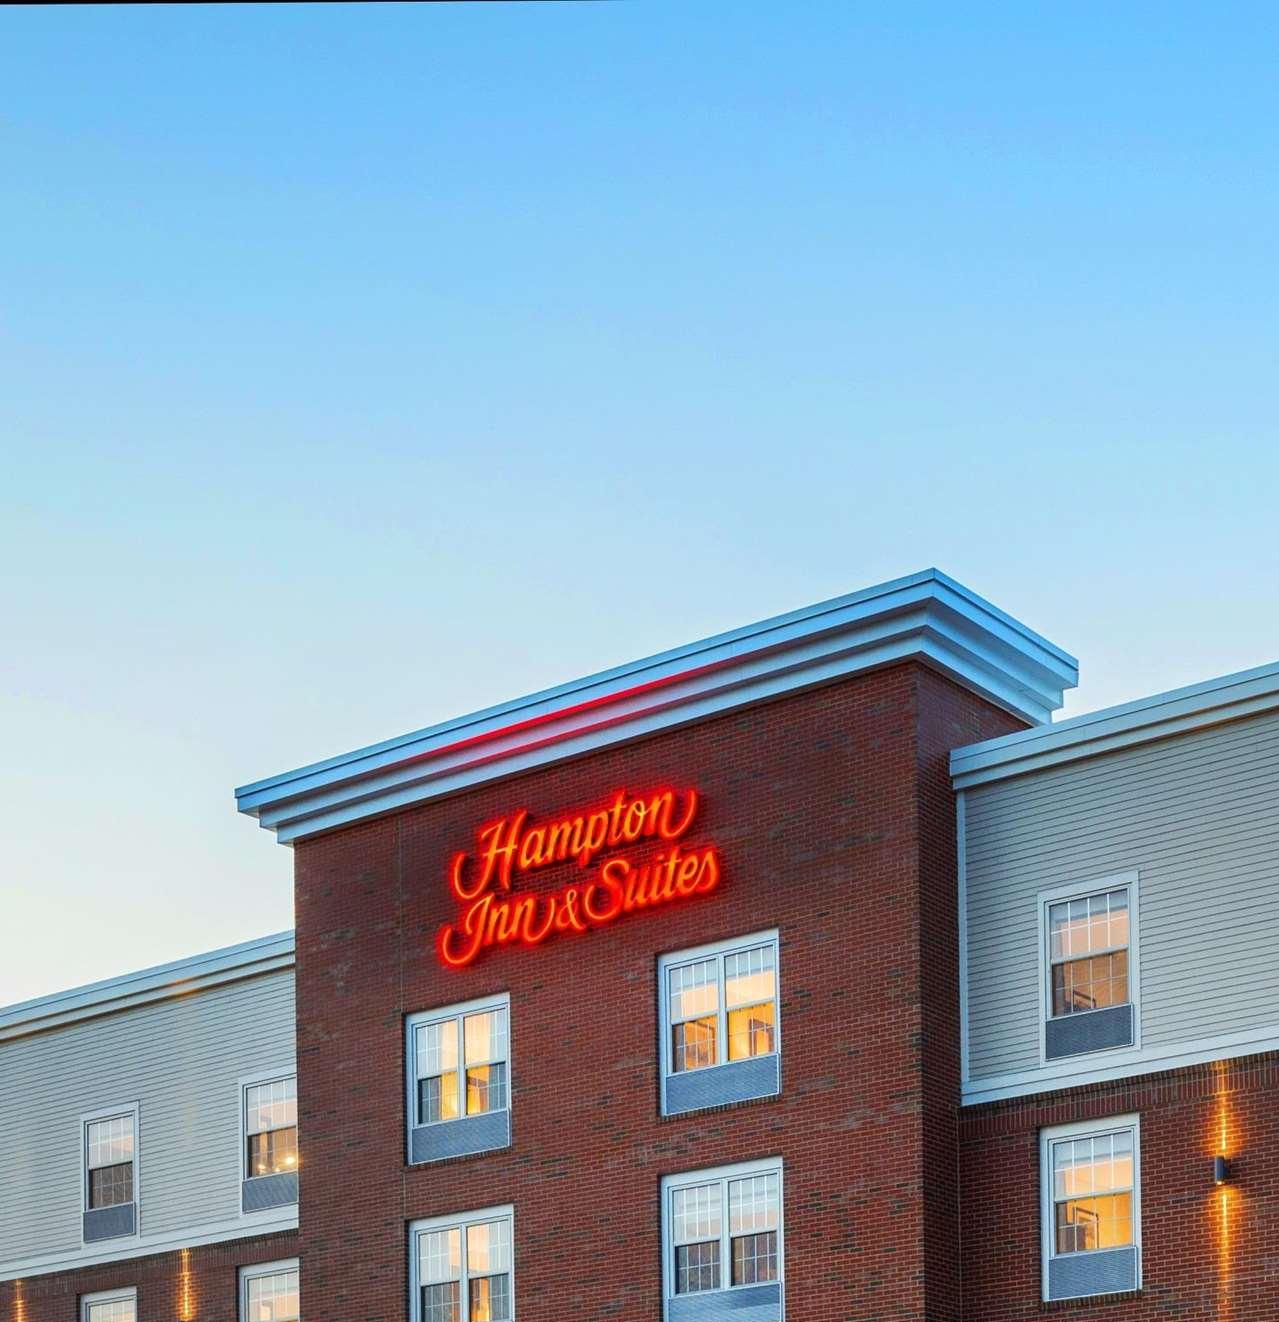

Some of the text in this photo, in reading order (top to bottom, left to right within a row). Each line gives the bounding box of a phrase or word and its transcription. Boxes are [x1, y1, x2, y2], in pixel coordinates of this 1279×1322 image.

[453, 789, 698, 901] Hampton
[441, 846, 719, 966] Inn & Suites
